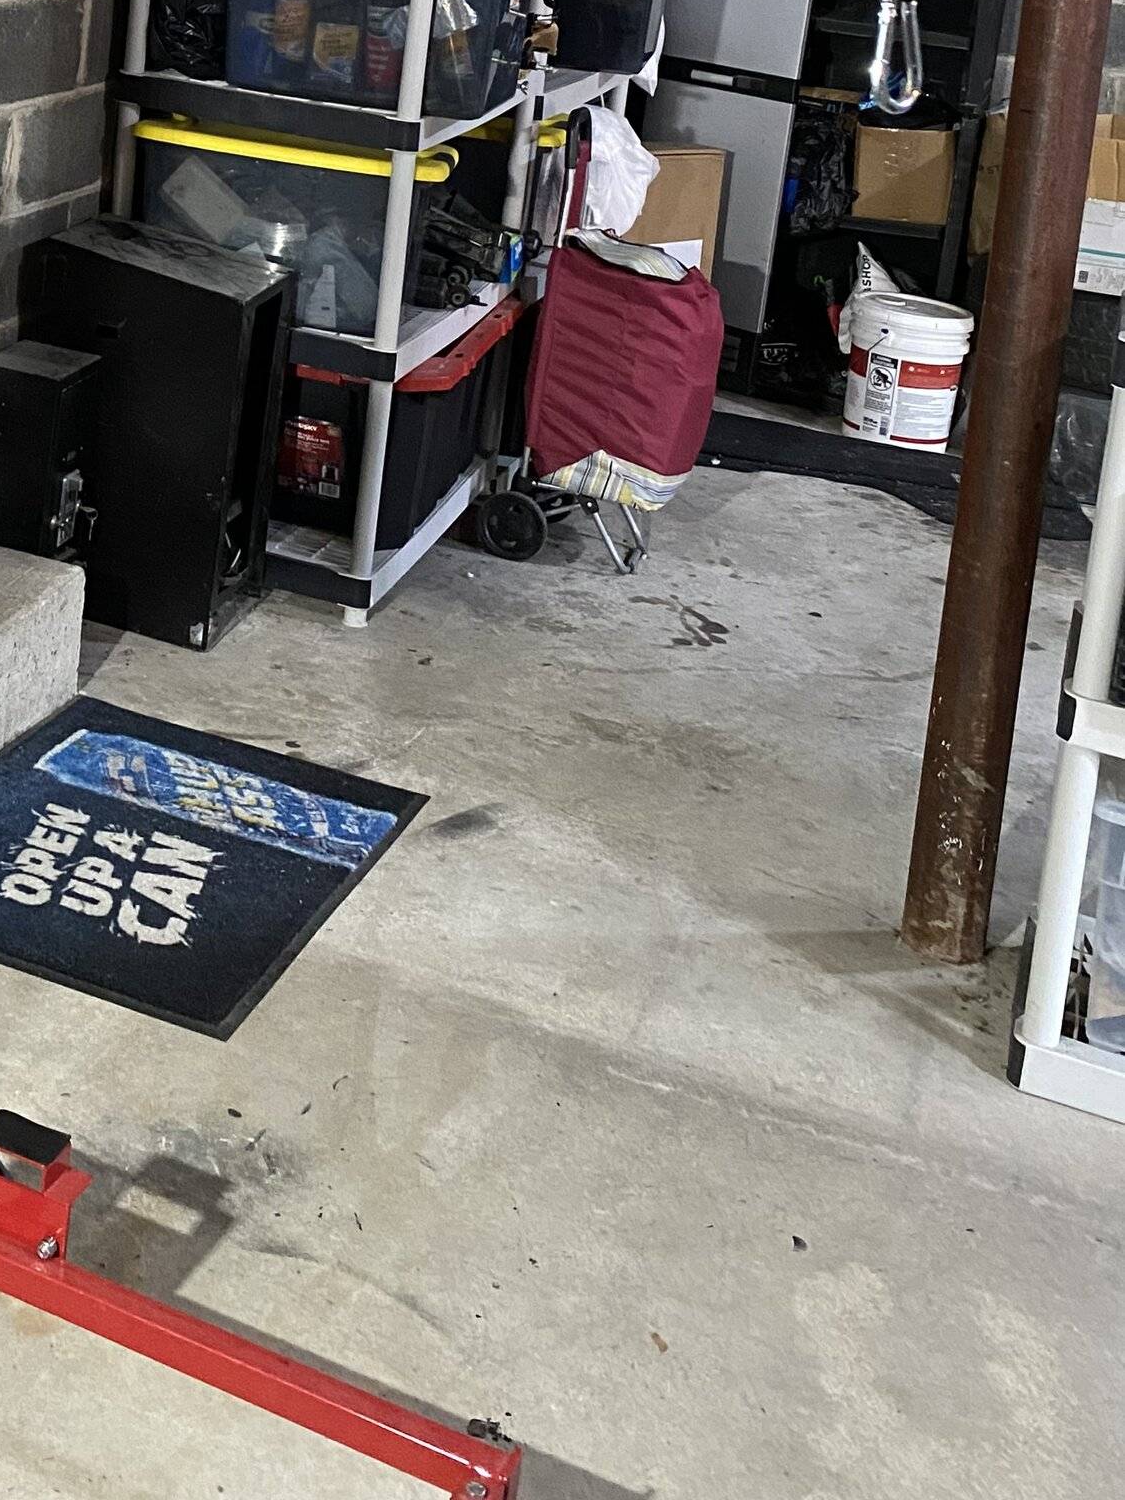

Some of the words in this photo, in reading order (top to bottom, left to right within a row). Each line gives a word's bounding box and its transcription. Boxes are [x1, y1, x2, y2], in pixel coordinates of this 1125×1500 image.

[861, 254, 872, 293] SHOP
[59, 856, 123, 917] UP
[93, 826, 145, 863] A
[117, 830, 222, 946] CAN
